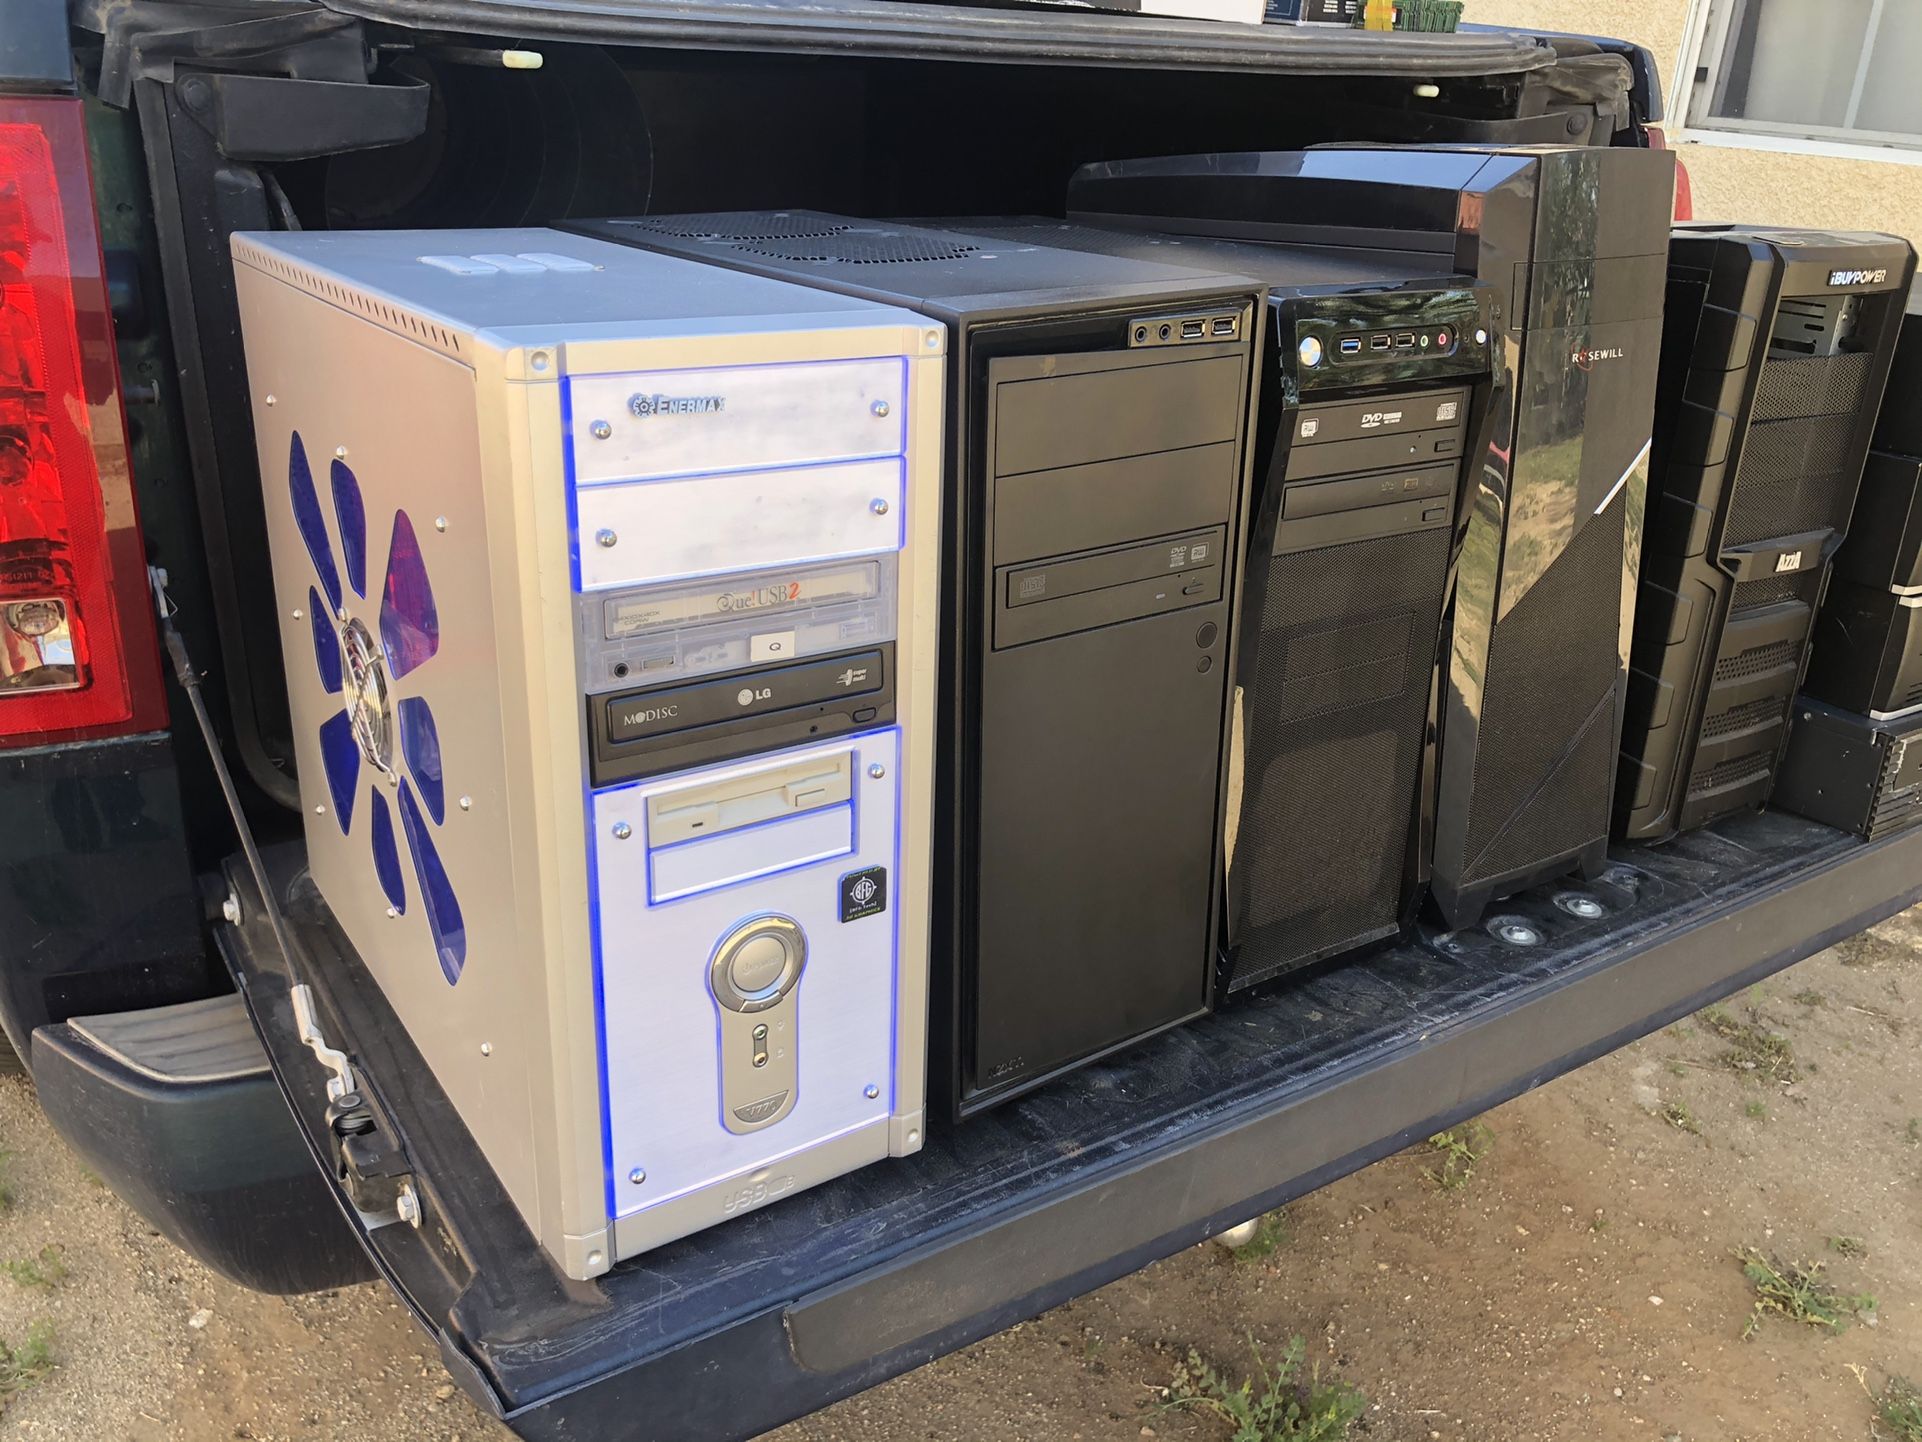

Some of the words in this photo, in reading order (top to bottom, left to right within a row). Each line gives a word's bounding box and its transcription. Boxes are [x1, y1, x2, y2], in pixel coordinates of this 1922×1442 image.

[1830, 269, 1887, 285] iBUYPOWER
[1361, 412, 1383, 424] DVD
[755, 688, 772, 700] LG
[855, 881, 873, 900] BFG
